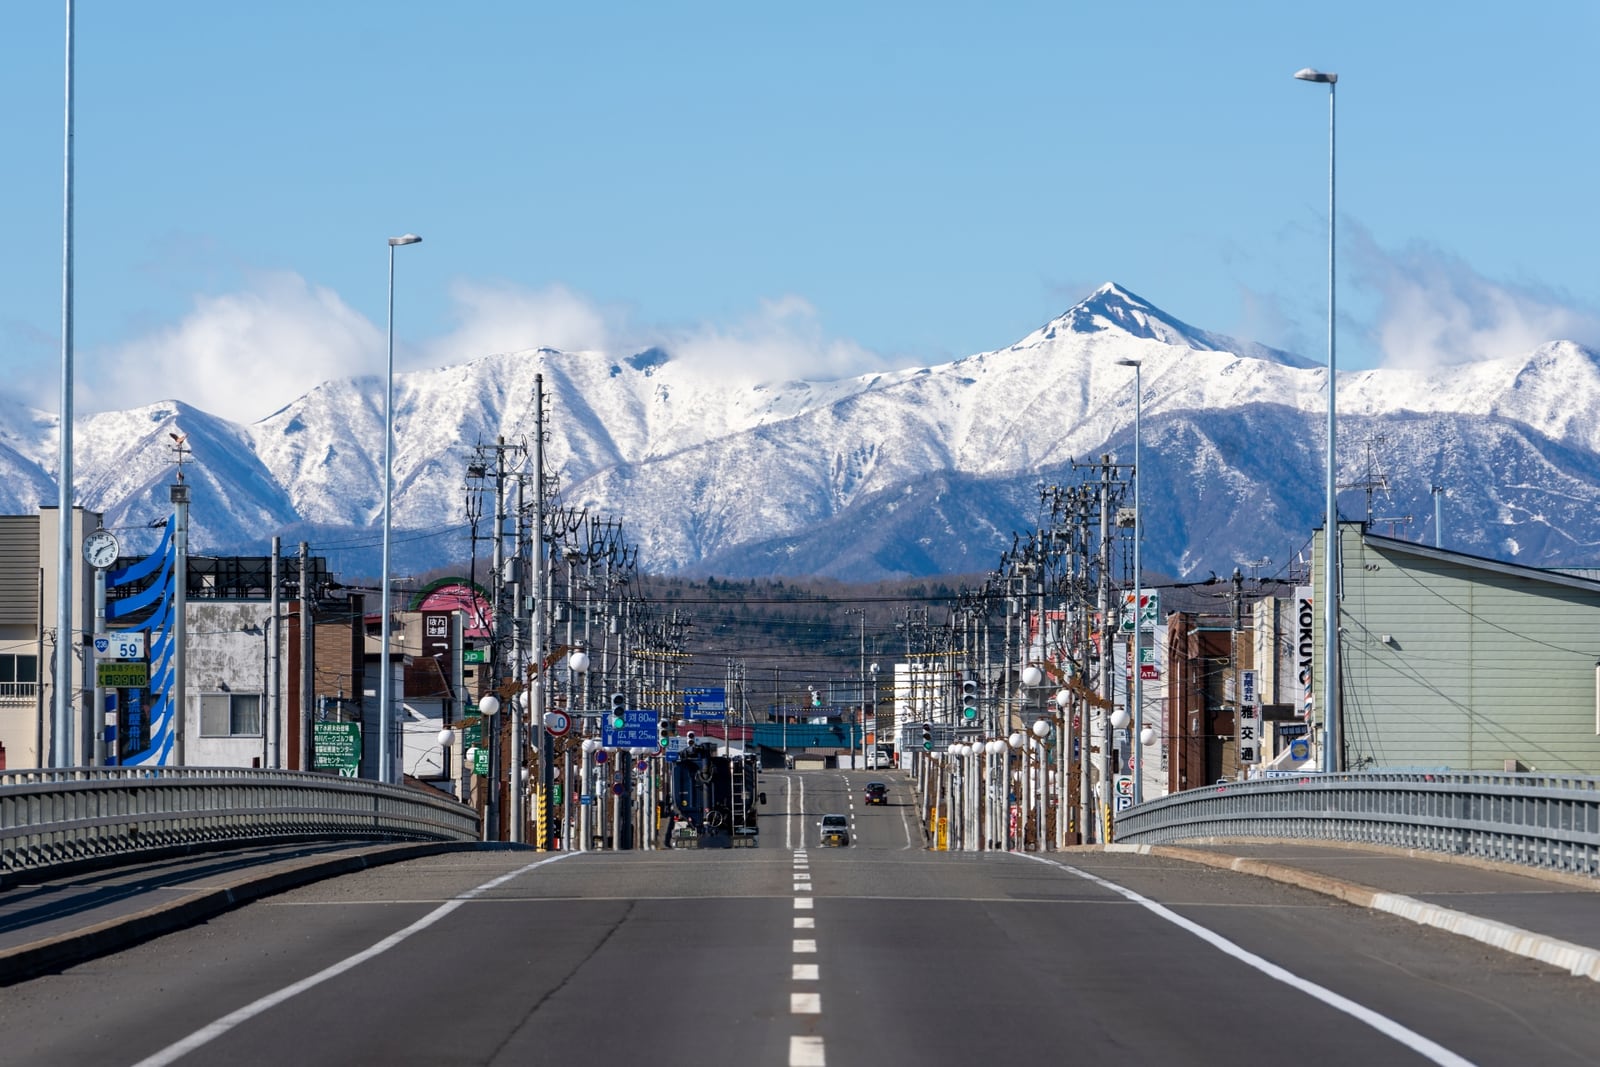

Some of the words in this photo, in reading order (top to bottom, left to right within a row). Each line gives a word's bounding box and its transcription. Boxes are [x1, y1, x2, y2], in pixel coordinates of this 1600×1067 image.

[119, 643, 137, 657] 59
[1243, 672, 1254, 702] 有限会社
[1241, 705, 1253, 761] 雅交通
